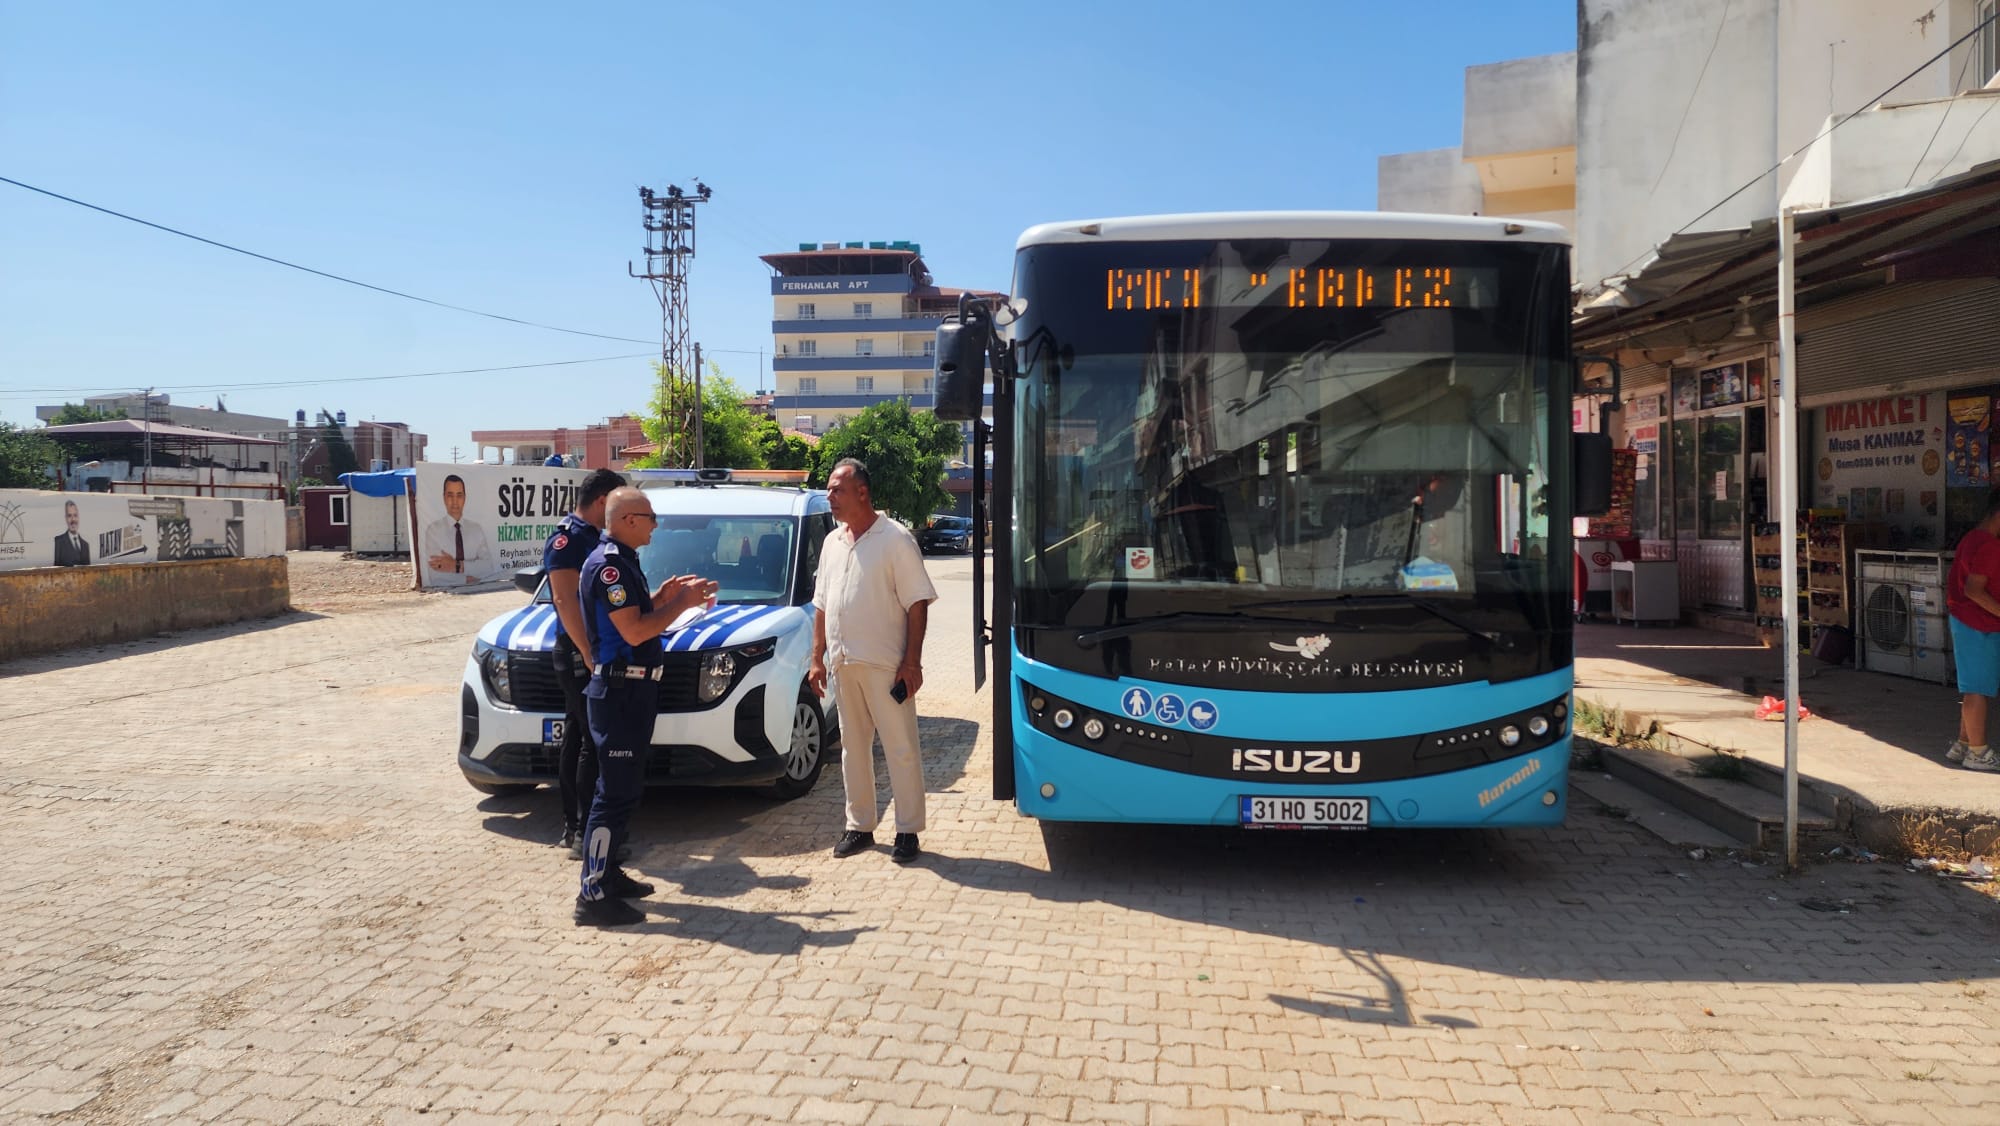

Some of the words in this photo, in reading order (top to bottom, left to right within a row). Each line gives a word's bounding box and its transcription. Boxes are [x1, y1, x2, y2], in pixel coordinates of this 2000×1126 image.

[782, 282, 840, 290] FERHANLAR
[848, 281, 869, 289] APT
[1825, 394, 1931, 432] MARKET
[1829, 438, 1861, 453] Musa
[1864, 430, 1925, 450] KANMAZ
[498, 477, 536, 518] SÖZ
[498, 522, 533, 542] HİZMET
[501, 547, 532, 559] Reyhanlı
[512, 560, 538, 569] Minibüs
[608, 750, 633, 758] ZABITA
[1232, 749, 1361, 774] ISUZU
[1254, 801, 1275, 820] 31
[1314, 802, 1364, 821] 5002
